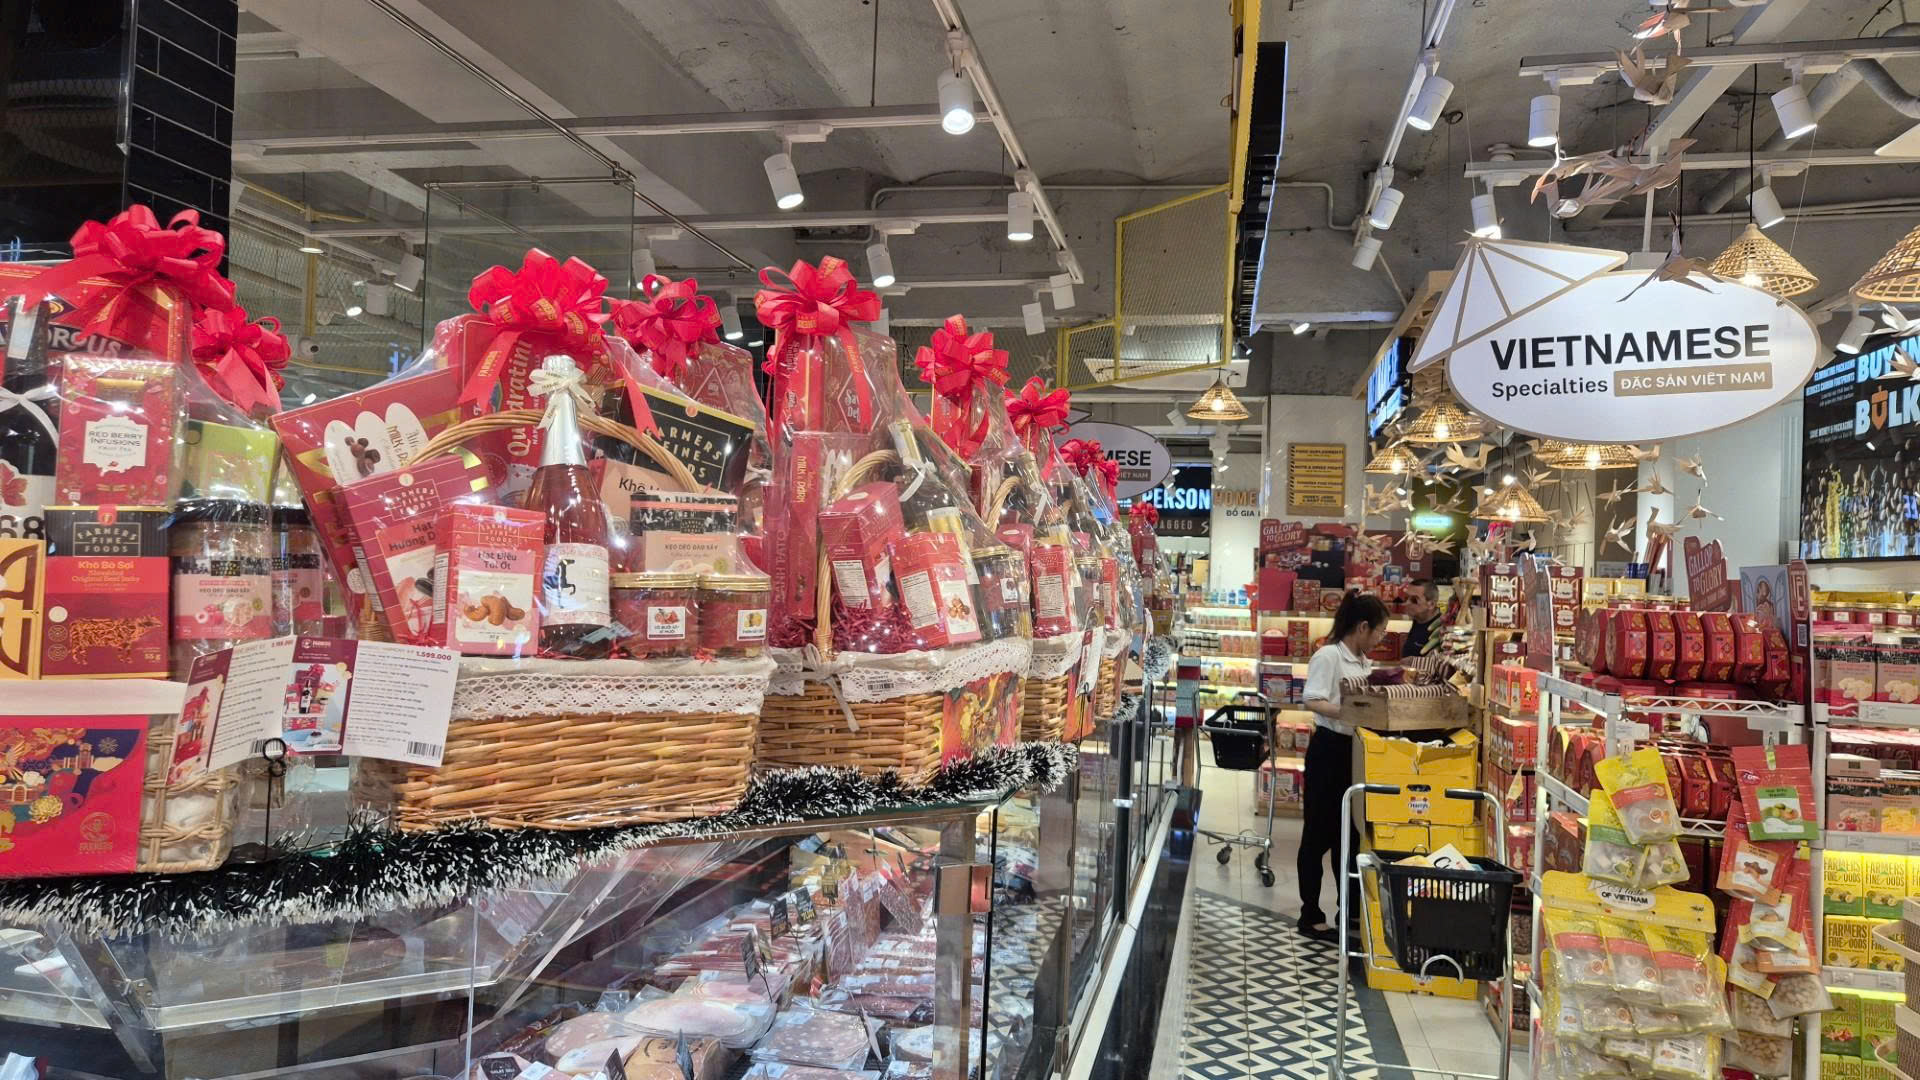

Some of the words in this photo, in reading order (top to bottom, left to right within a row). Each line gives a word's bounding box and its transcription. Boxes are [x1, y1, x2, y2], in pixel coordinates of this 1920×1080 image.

[1490, 324, 1770, 370] VIETNAMESE
[1857, 344, 1896, 383] BUY
[1492, 377, 1608, 401] Specialties
[1621, 376, 1652, 391] ĐẶC
[1656, 373, 1687, 388] SẢN
[1730, 371, 1766, 384] NAM
[506, 340, 531, 457] Qudratini
[663, 441, 702, 461] FINE
[1214, 490, 1257, 506] HOME
[77, 528, 137, 540] FARMERS
[1263, 524, 1294, 536] GALLOP
[1275, 529, 1302, 543] GLORY
[1689, 543, 1713, 576] GALLOP
[1866, 861, 1905, 877] FARMERS
[1614, 893, 1649, 905] VIETNAM
[1829, 921, 1867, 939] FARMERS
[1829, 936, 1842, 948] FINE
